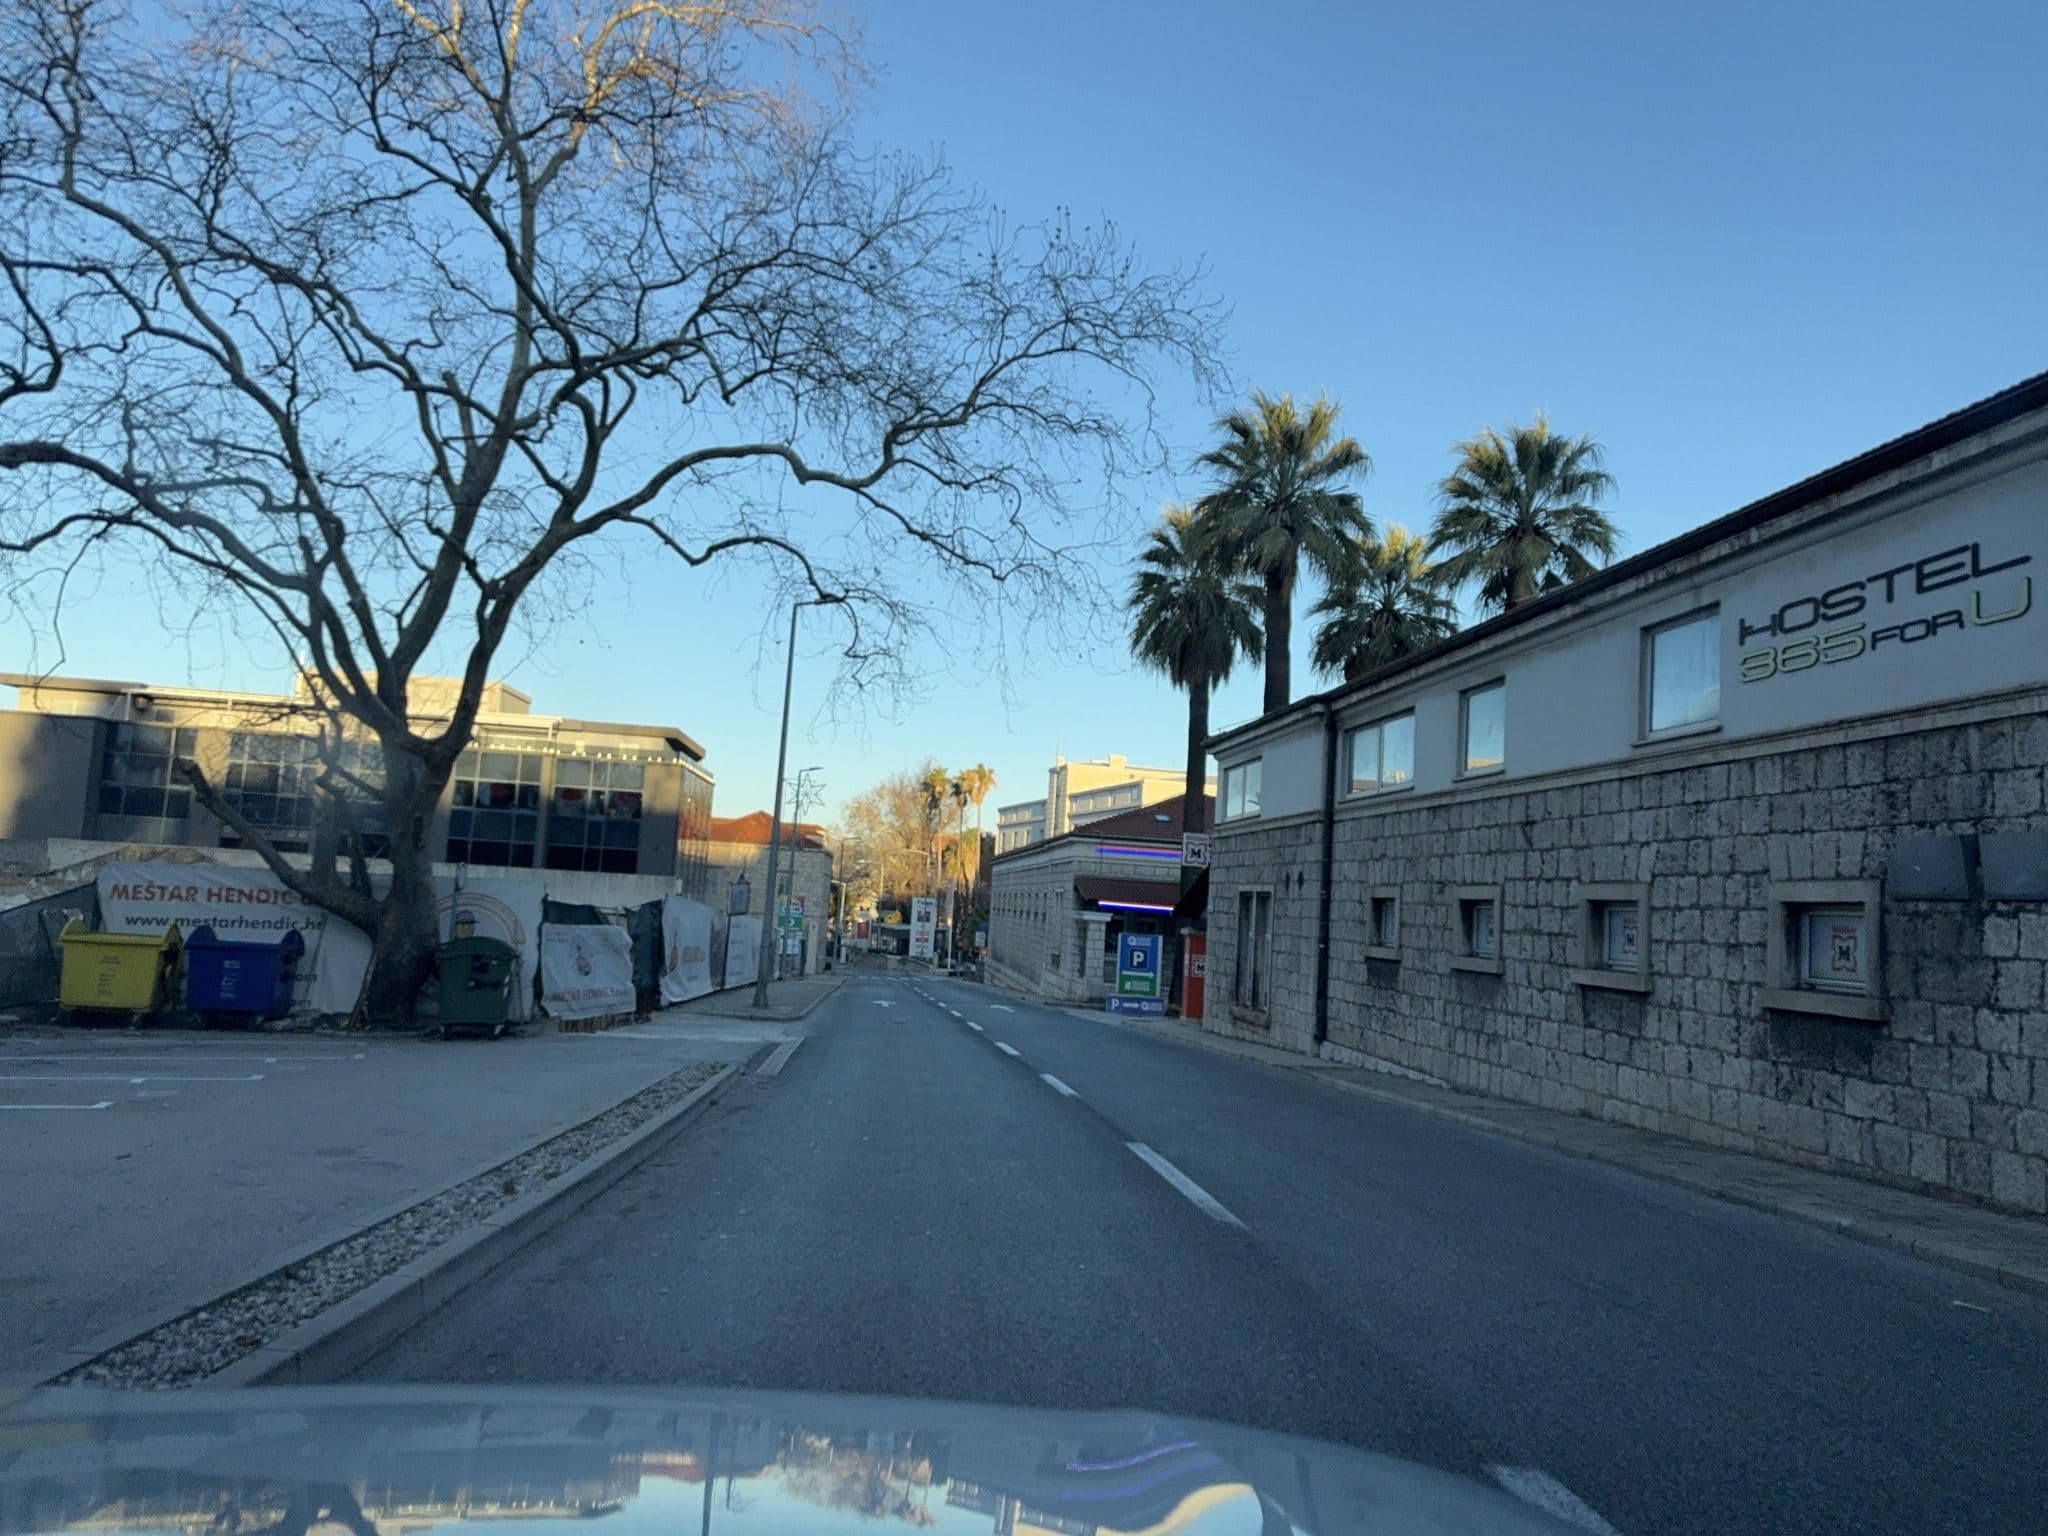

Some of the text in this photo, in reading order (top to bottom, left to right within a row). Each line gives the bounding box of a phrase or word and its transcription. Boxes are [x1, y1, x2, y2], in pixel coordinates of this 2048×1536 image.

[1738, 541, 2033, 646] HOSTEL
[1740, 575, 2033, 683] 365 FOR U
[110, 880, 199, 902] MEŠTAR
[1132, 951, 1145, 967] P
[1111, 998, 1120, 1010] P
